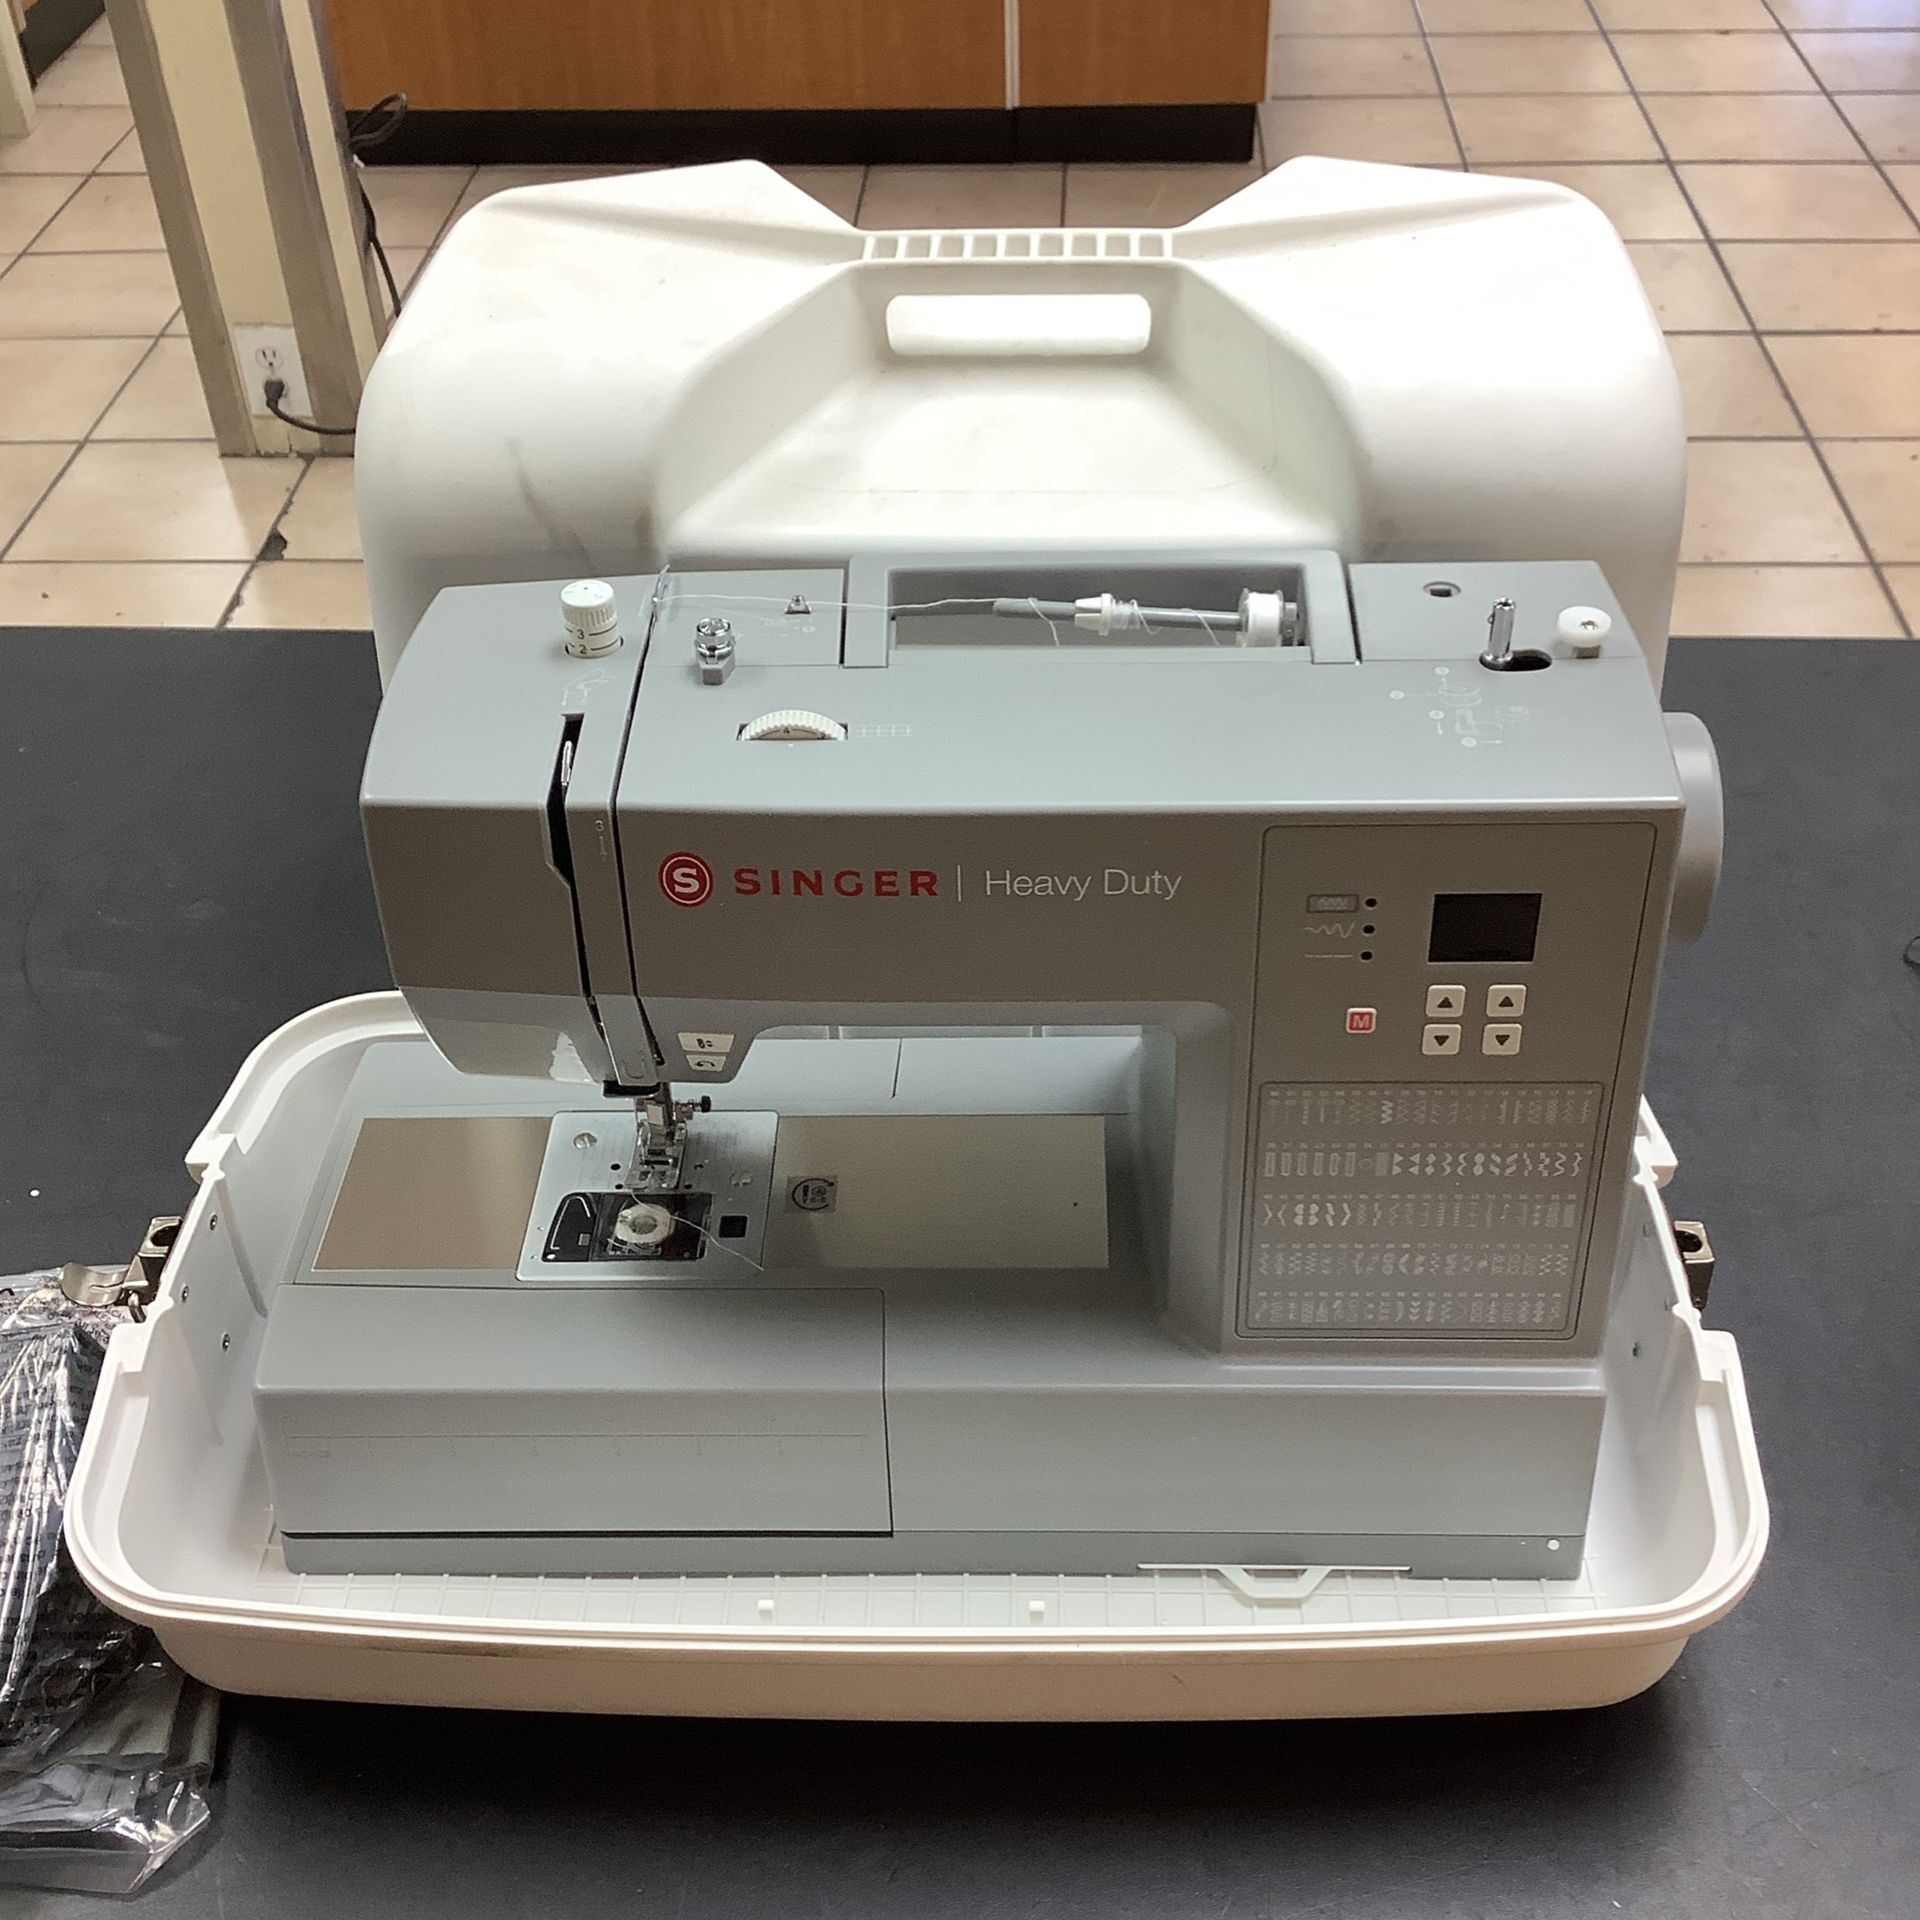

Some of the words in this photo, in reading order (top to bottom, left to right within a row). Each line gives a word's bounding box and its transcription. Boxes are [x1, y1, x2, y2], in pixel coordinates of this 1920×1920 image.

[576, 628, 585, 640] 3
[578, 643, 587, 655] 2
[733, 867, 940, 898] SINGER
[985, 868, 1091, 901] Heavy
[1103, 868, 1183, 901] Duty
[1351, 1014, 1370, 1029] M
